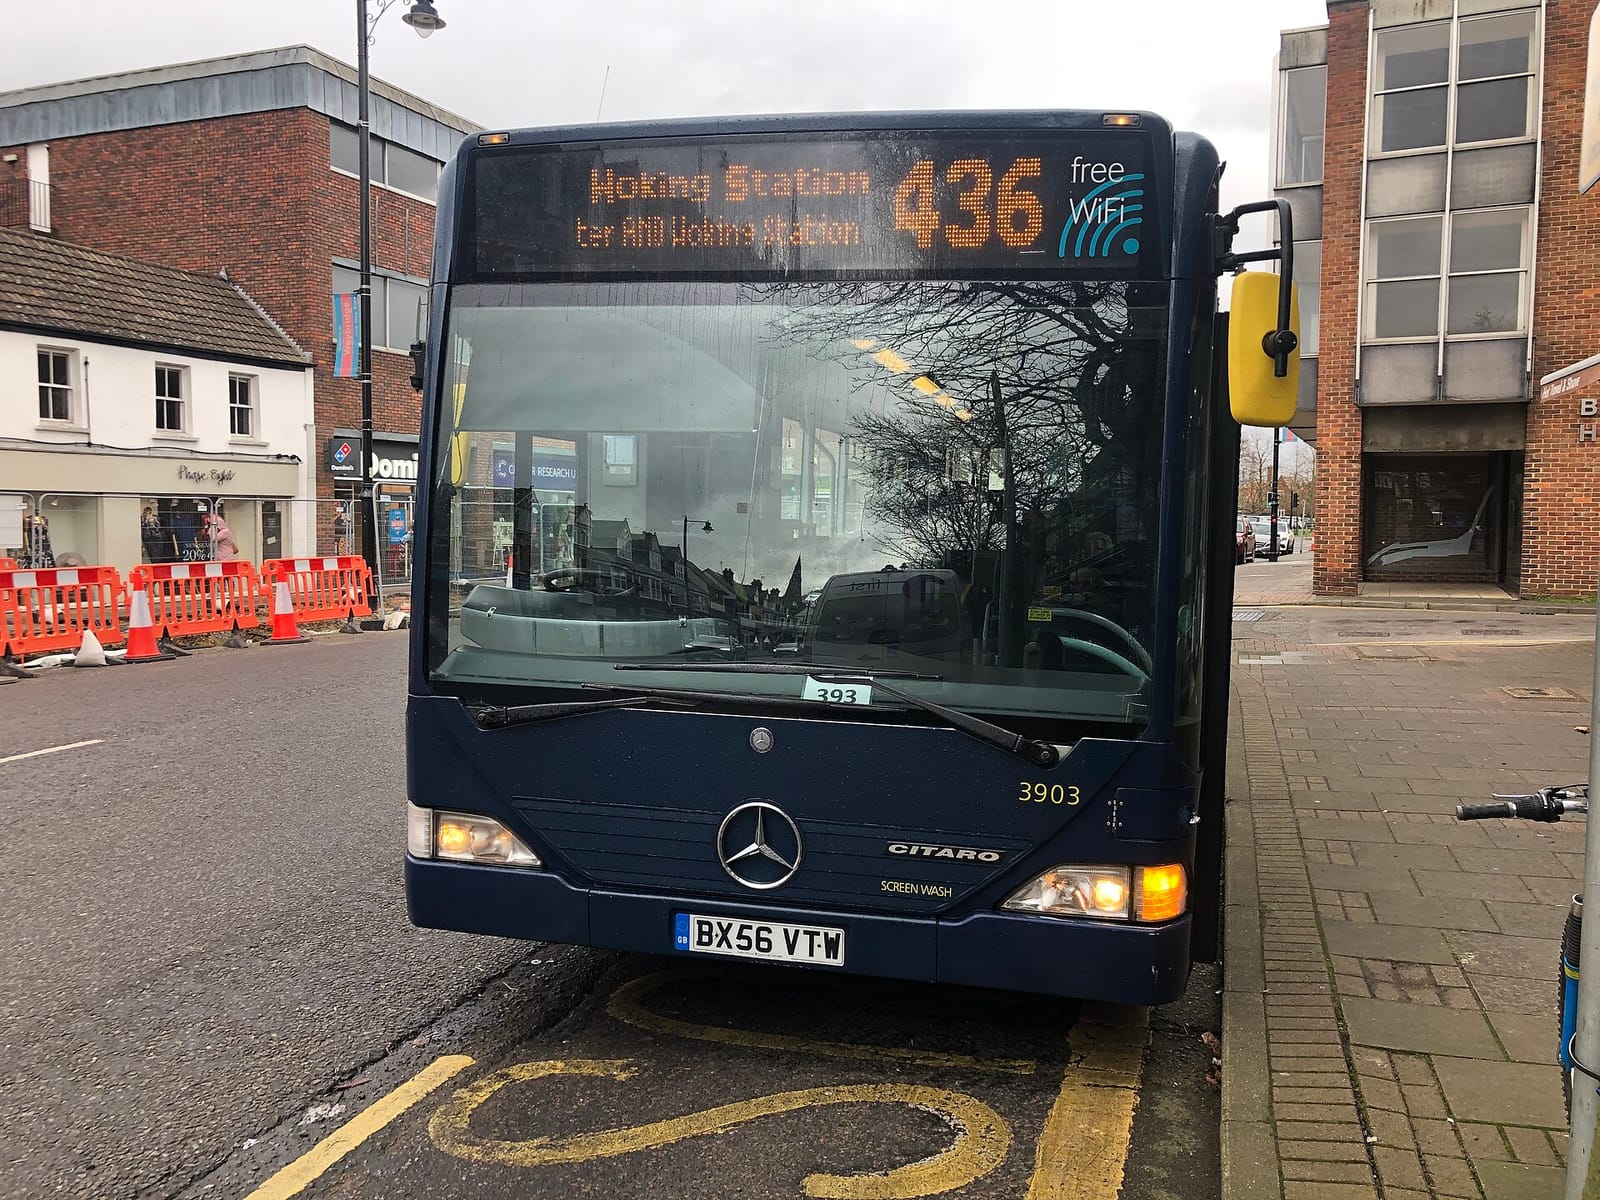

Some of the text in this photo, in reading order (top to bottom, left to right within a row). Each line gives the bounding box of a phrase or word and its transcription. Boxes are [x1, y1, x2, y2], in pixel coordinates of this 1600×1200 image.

[1070, 156, 1125, 184] free
[591, 164, 870, 204] Woking Station
[893, 157, 1044, 248] 436
[1069, 196, 1126, 225] WiFi
[671, 214, 755, 247] Woking
[763, 212, 861, 246] Station
[178, 464, 236, 487] Phase Eight
[360, 450, 419, 479] Domi
[537, 466, 570, 479] RESEARCH
[817, 688, 857, 704] 393
[1018, 781, 1081, 806] 3903
[888, 844, 1000, 862] CITARO
[880, 880, 952, 898] SCREEN WASH
[677, 936, 688, 944] GB
[696, 919, 842, 961] BX56 VTW
